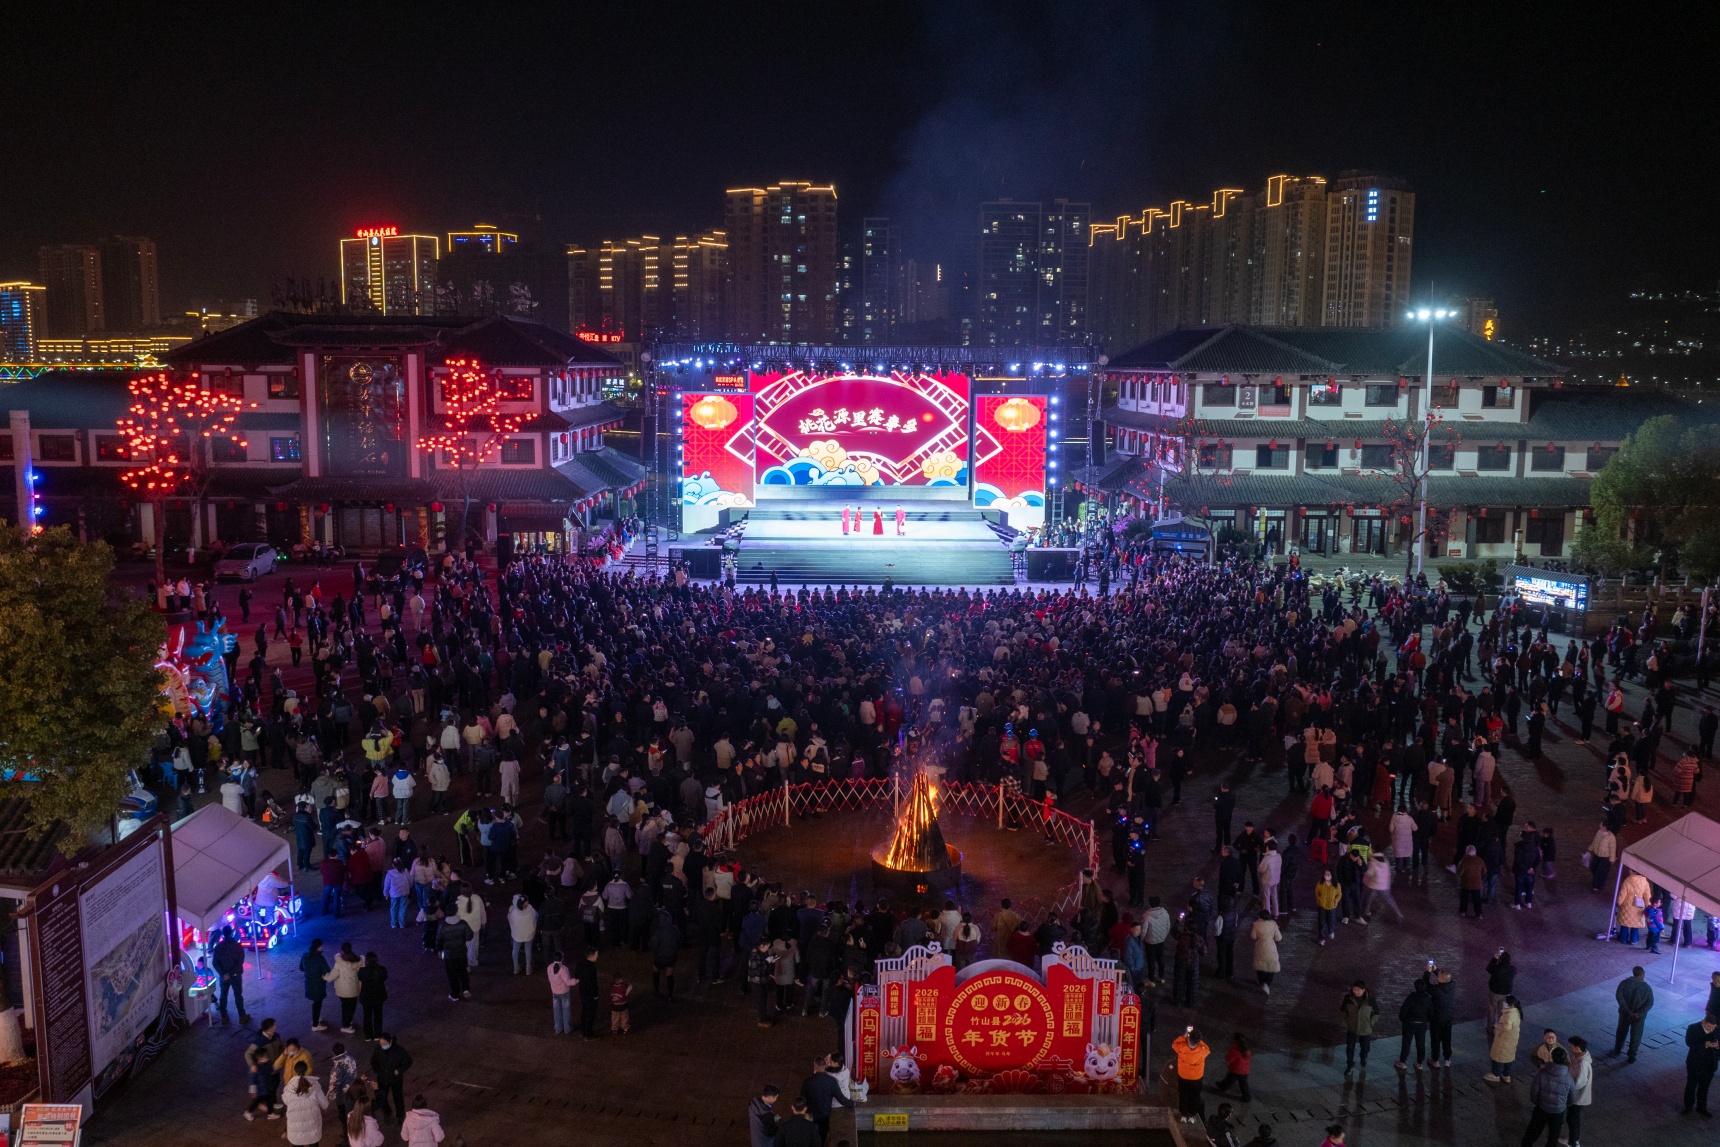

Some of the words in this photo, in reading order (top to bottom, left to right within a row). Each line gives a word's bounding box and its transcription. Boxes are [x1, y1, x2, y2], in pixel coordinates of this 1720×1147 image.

[915, 988, 939, 997] 2026
[1063, 984, 1087, 993] 2026
[972, 995, 1030, 1010] 迎新春
[917, 1025, 934, 1040] 福
[1064, 1021, 1081, 1035] 福
[961, 1029, 1038, 1047] 年货节
[1122, 1015, 1136, 1076] 马年吉祥
[862, 1018, 876, 1080] 马年吉祥
